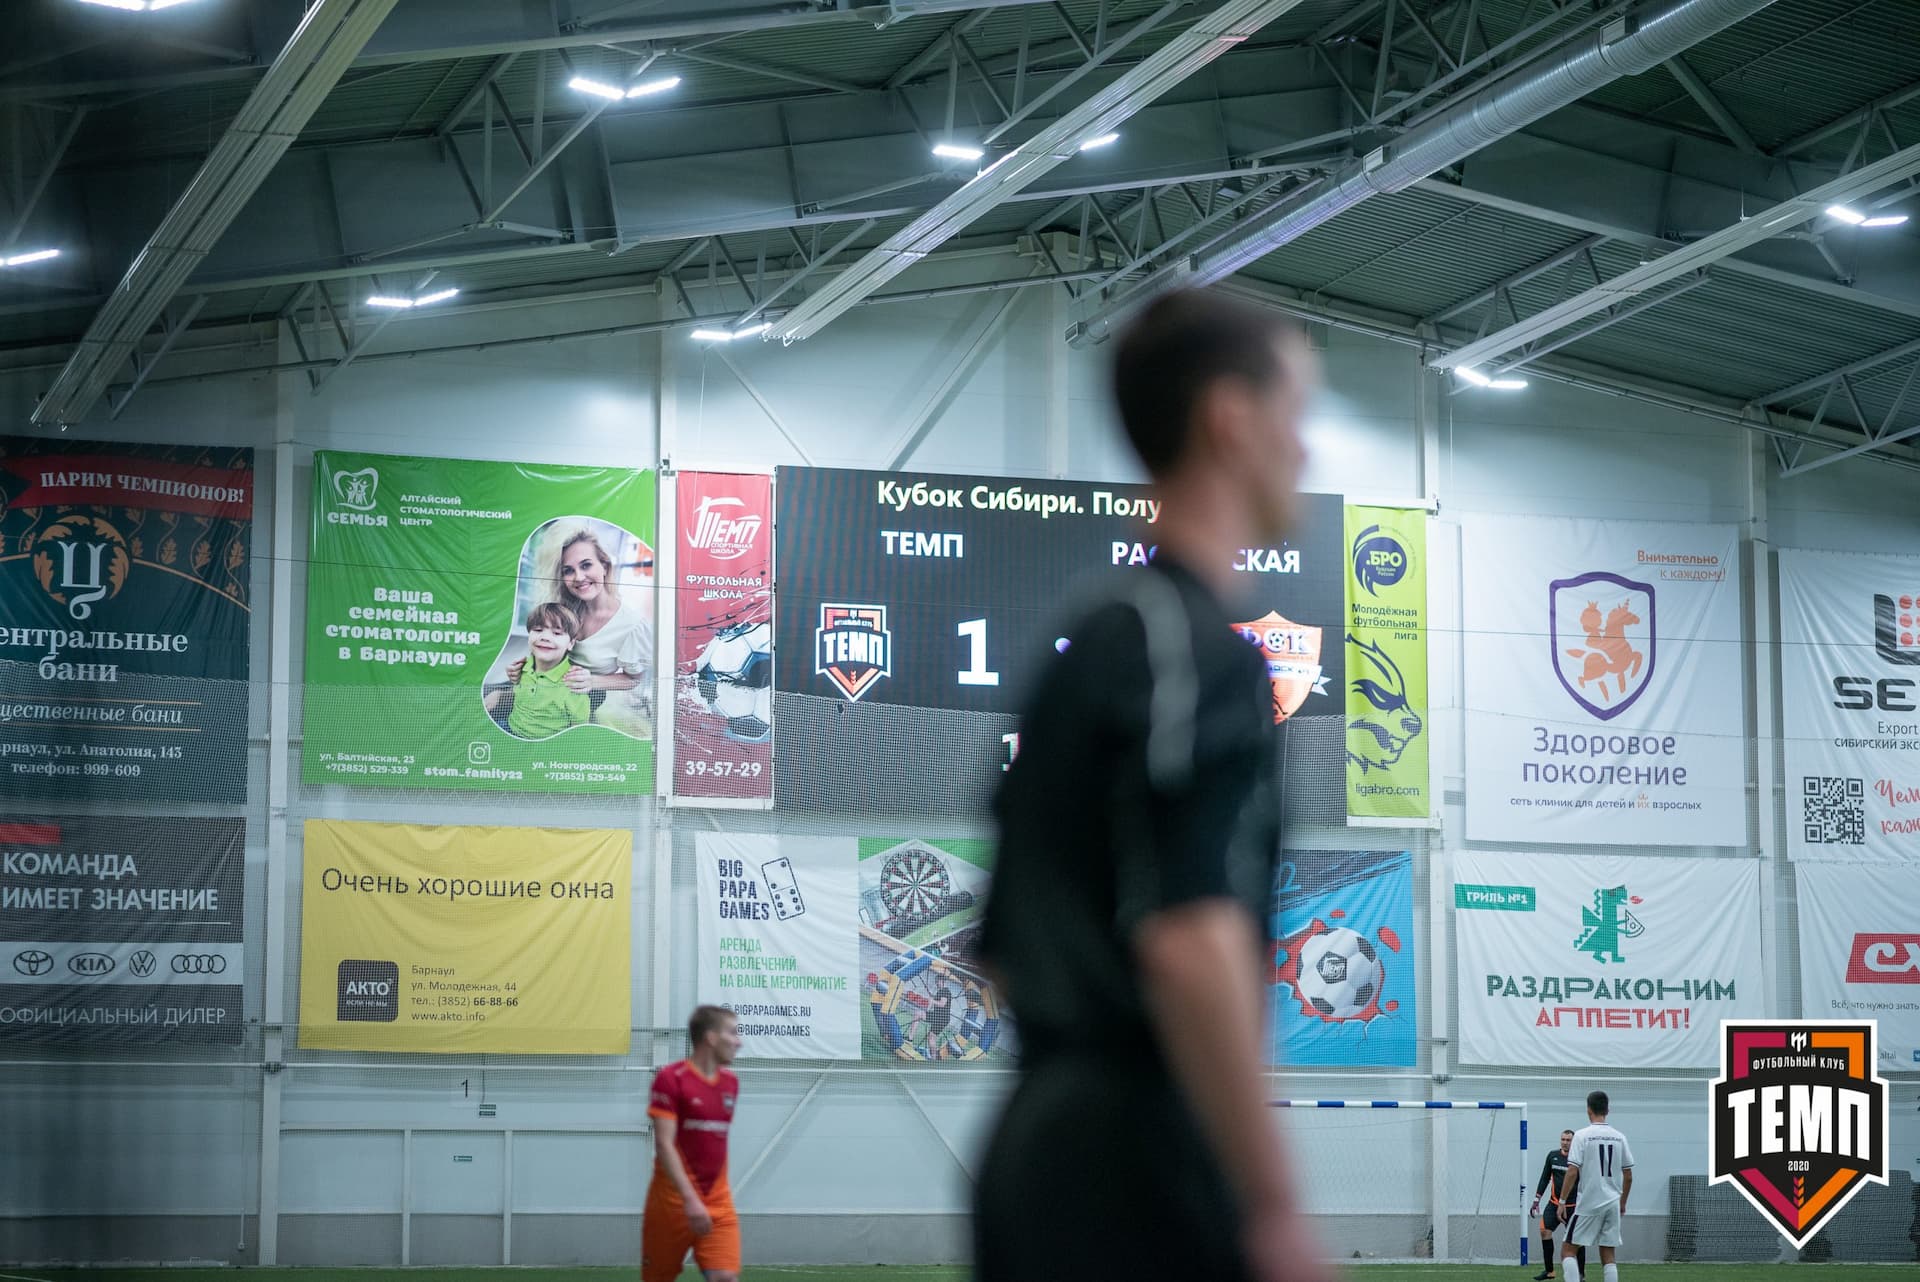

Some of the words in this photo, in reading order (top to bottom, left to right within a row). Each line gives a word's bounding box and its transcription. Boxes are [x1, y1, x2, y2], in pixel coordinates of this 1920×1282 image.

[40, 472, 112, 489] ПАРИМ
[118, 475, 245, 503] ЧЕМПИОНОВ!
[400, 494, 461, 505] АЛТАЙСКИЙ
[877, 480, 963, 511] Кубок
[970, 485, 1084, 519] Сибири.
[328, 512, 388, 527] СЕМЬЯ
[399, 506, 512, 520] СТОМАТОЛОГИЧЕСКИЙ
[400, 517, 432, 526] ЦЕНТР
[881, 530, 964, 558] ТЕМП
[1637, 550, 1719, 565] Внимательно
[686, 575, 762, 587] ФУТБОЛЬНАЯ
[1660, 569, 1666, 578] к
[1671, 568, 1726, 582] каждому!
[374, 587, 433, 604] Ваша
[703, 588, 743, 599] ШКОЛА
[349, 606, 458, 625] семейная
[1351, 603, 1418, 616] Молодёжная
[1353, 616, 1418, 629] футбольная
[326, 624, 480, 645] стоматология
[1394, 632, 1418, 641] лига
[338, 647, 351, 660] в
[360, 647, 466, 667] Барнауле
[823, 631, 884, 667] ТЕМП
[956, 618, 1000, 686] 1
[39, 654, 119, 682] бани
[132, 704, 183, 724] бани
[1878, 721, 1919, 736] Export
[1533, 727, 1676, 758] Здоровое
[1834, 738, 1897, 749] СИБИРСКИЙ
[54, 744, 76, 758] ул.
[80, 744, 157, 760] Анатолия,
[11, 763, 80, 777] телефон:
[84, 763, 141, 777] 999-609
[424, 766, 523, 780] stom_family22
[686, 761, 762, 777] 39-57-29
[1523, 762, 1687, 786] поколение
[1356, 783, 1420, 797] ligabro.com
[1510, 798, 1533, 807] сеть
[1535, 798, 1573, 808] клиник
[1575, 800, 1593, 809] для
[1595, 797, 1626, 809] детей
[1628, 801, 1635, 809] и
[1652, 800, 1702, 812] взрослых
[3, 852, 137, 880] КОМАНДА
[719, 859, 743, 878] BIG
[322, 867, 408, 895] Очень
[418, 876, 541, 901] хорошие
[550, 880, 614, 900] окна
[719, 880, 757, 899] PAPA
[3, 886, 83, 910] ИМЕЕТ
[91, 888, 218, 911] ЗНАЧЕНИЕ
[1466, 892, 1505, 903] ГРИЛЬ
[719, 901, 770, 921] GAMES
[720, 937, 762, 953] АРЕНДА
[411, 965, 455, 976] Барнаул
[720, 955, 797, 971] РАЗВЛЕЧЕНИЙ
[411, 982, 426, 992] ул.
[504, 982, 517, 991] 44
[720, 974, 734, 988] НА
[737, 974, 768, 989] ВАШЕ
[770, 975, 848, 990] МЕРОПРИЯТИЕ
[1486, 974, 1736, 1003] РАЗДРАКОНИМ
[438, 996, 470, 1008] (3852)
[473, 997, 519, 1007] 66-88-66
[1851, 1001, 1865, 1009] что
[1867, 1001, 1894, 1011] нужно
[0, 1004, 158, 1027] ОФИЦИАЛЬНЫЙ
[163, 1008, 226, 1027] ДИЛЕР
[411, 1010, 486, 1022] www.akto.info
[734, 1004, 812, 1017] BIGPAPAGAMES.RU
[1535, 1006, 1690, 1029] АППЕТИТ!
[736, 1023, 811, 1037] @BIGPAPAGAMES
[461, 1079, 469, 1099] 1
[1599, 1143, 1613, 1178] 11
